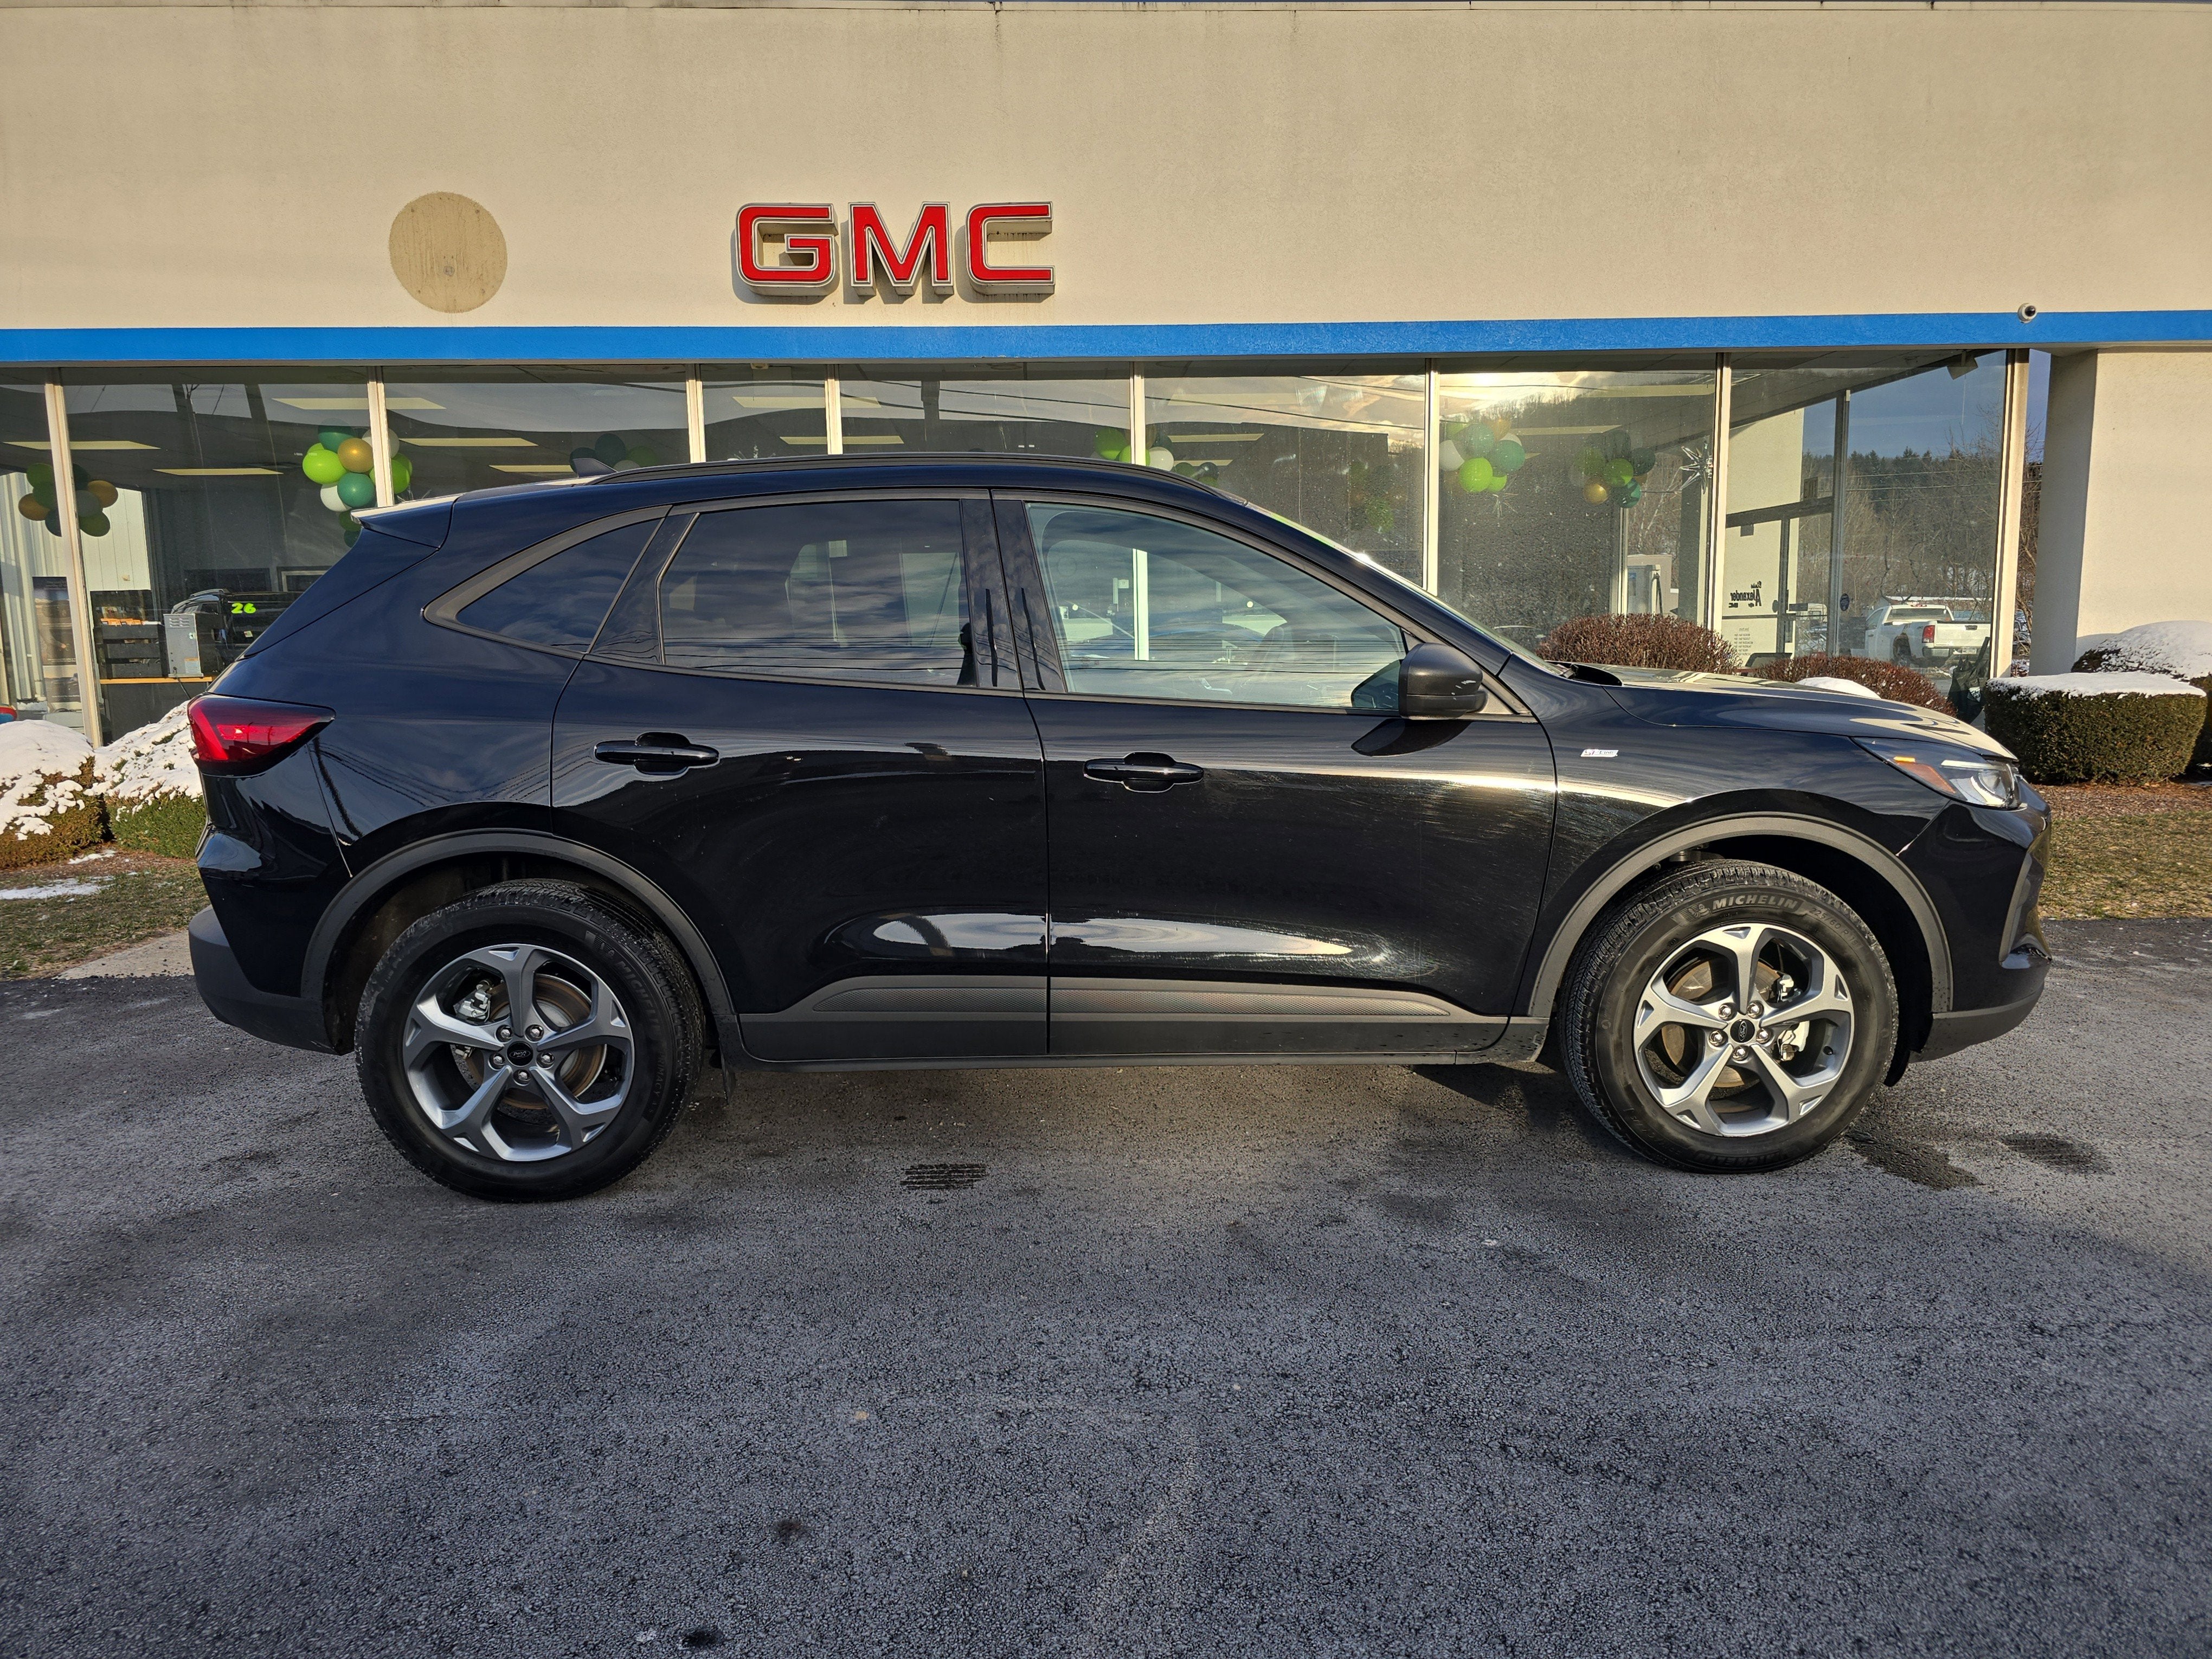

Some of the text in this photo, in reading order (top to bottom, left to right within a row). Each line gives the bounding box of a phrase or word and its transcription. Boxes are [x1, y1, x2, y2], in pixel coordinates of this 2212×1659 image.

[736, 201, 1056, 288] GMC
[231, 602, 256, 614] 26
[1712, 894, 1798, 910] MICHELIN
